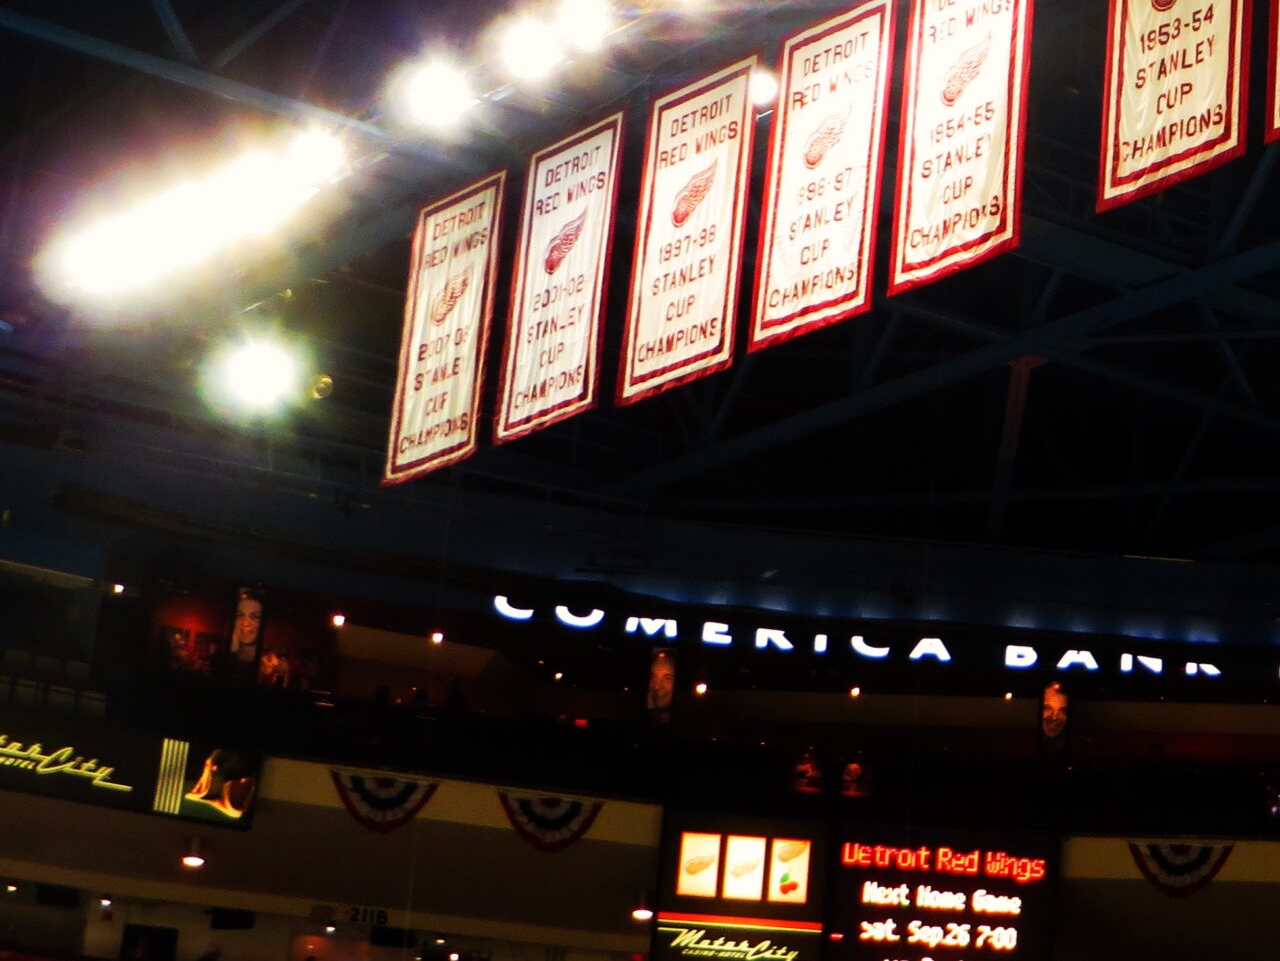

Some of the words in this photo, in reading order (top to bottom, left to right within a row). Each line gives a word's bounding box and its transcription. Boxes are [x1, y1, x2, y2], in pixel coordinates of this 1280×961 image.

[1140, 3, 1214, 55] 1953-54
[1135, 35, 1215, 90] STANLEY
[670, 93, 732, 138] DETROIT
[1156, 82, 1193, 116] CUP
[658, 143, 687, 169] RED
[695, 121, 738, 154] WINGS
[1120, 103, 1223, 163] CHAMPIONS
[659, 224, 716, 265] 1997-98
[652, 254, 716, 296] STANLEY
[665, 295, 696, 322] CUP
[637, 317, 718, 363] CHAMPIONS
[935, 847, 980, 875] Red
[985, 851, 1046, 883] Wings
[862, 880, 911, 907] Next
[916, 884, 967, 911] Home
[971, 889, 1022, 915] Game
